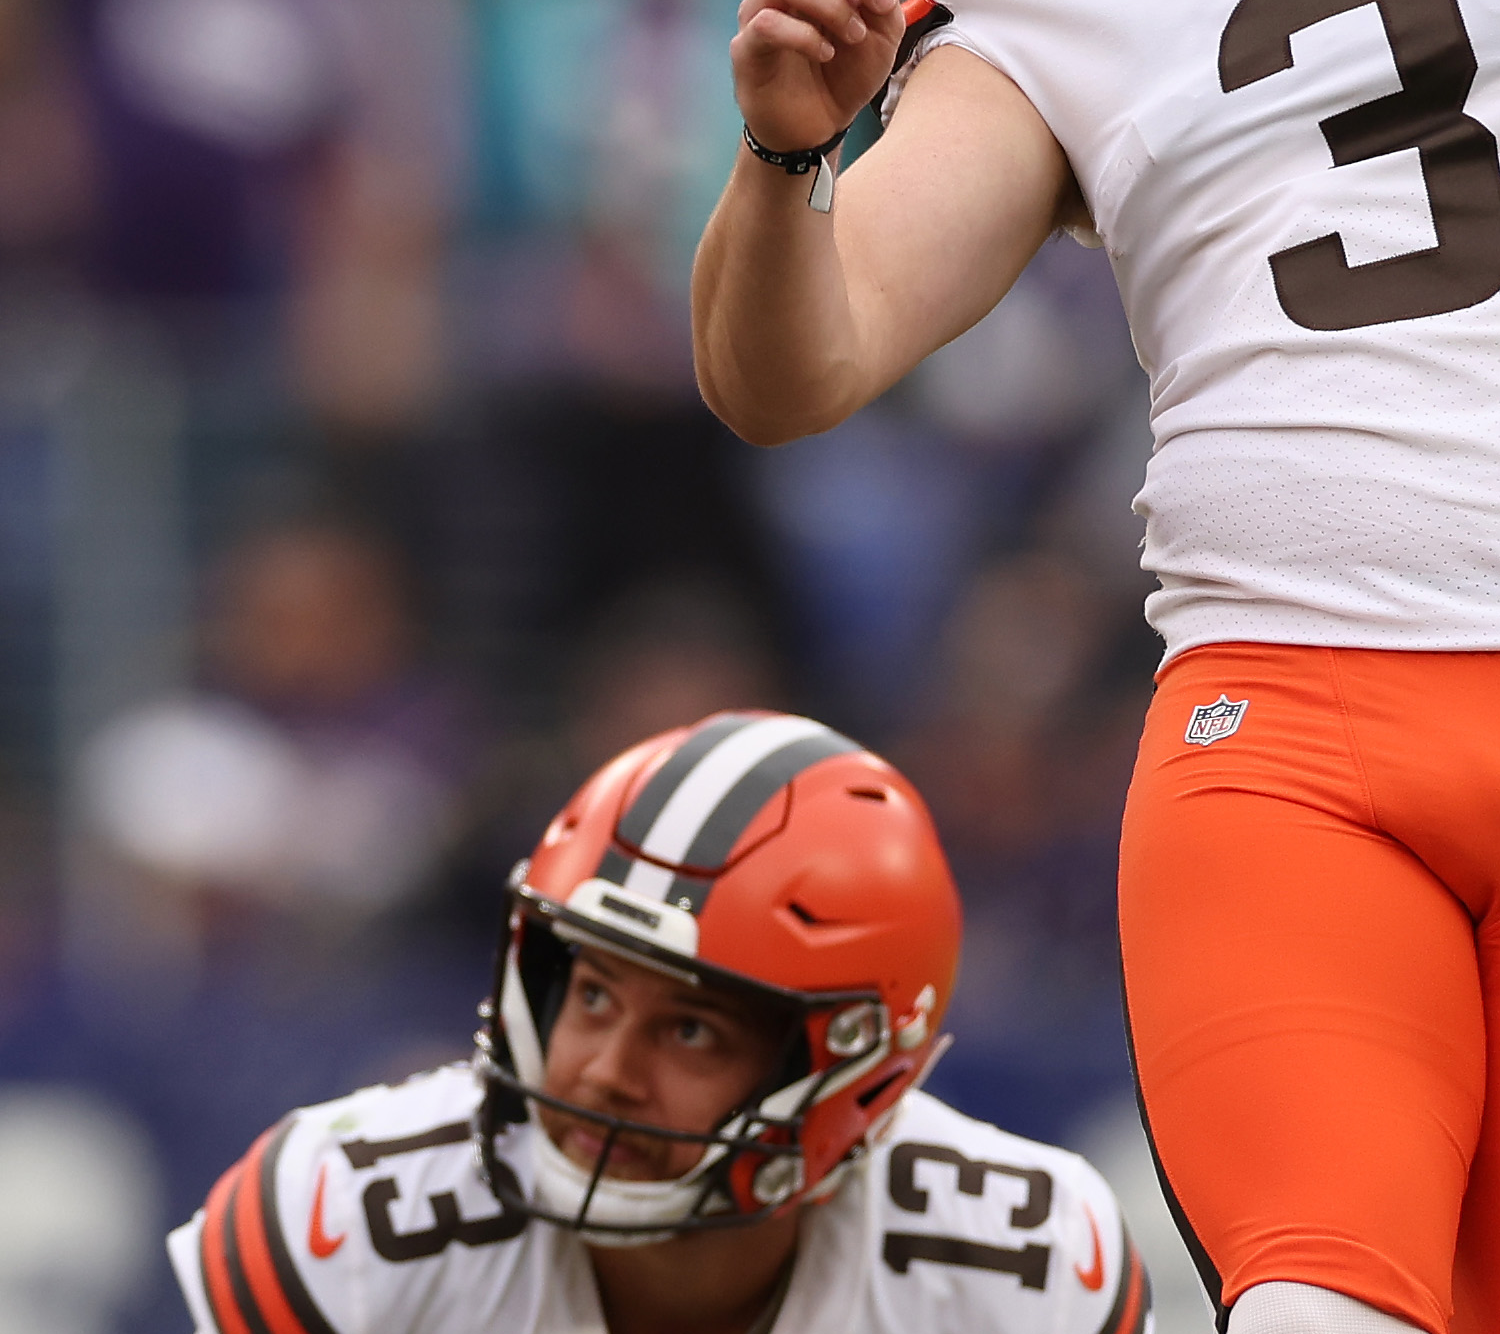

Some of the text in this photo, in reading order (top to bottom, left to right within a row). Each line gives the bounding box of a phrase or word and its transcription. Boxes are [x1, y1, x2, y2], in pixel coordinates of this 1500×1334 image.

[1193, 716, 1230, 736] NFL
[340, 1121, 528, 1262] 13
[883, 1142, 1053, 1292] 13
